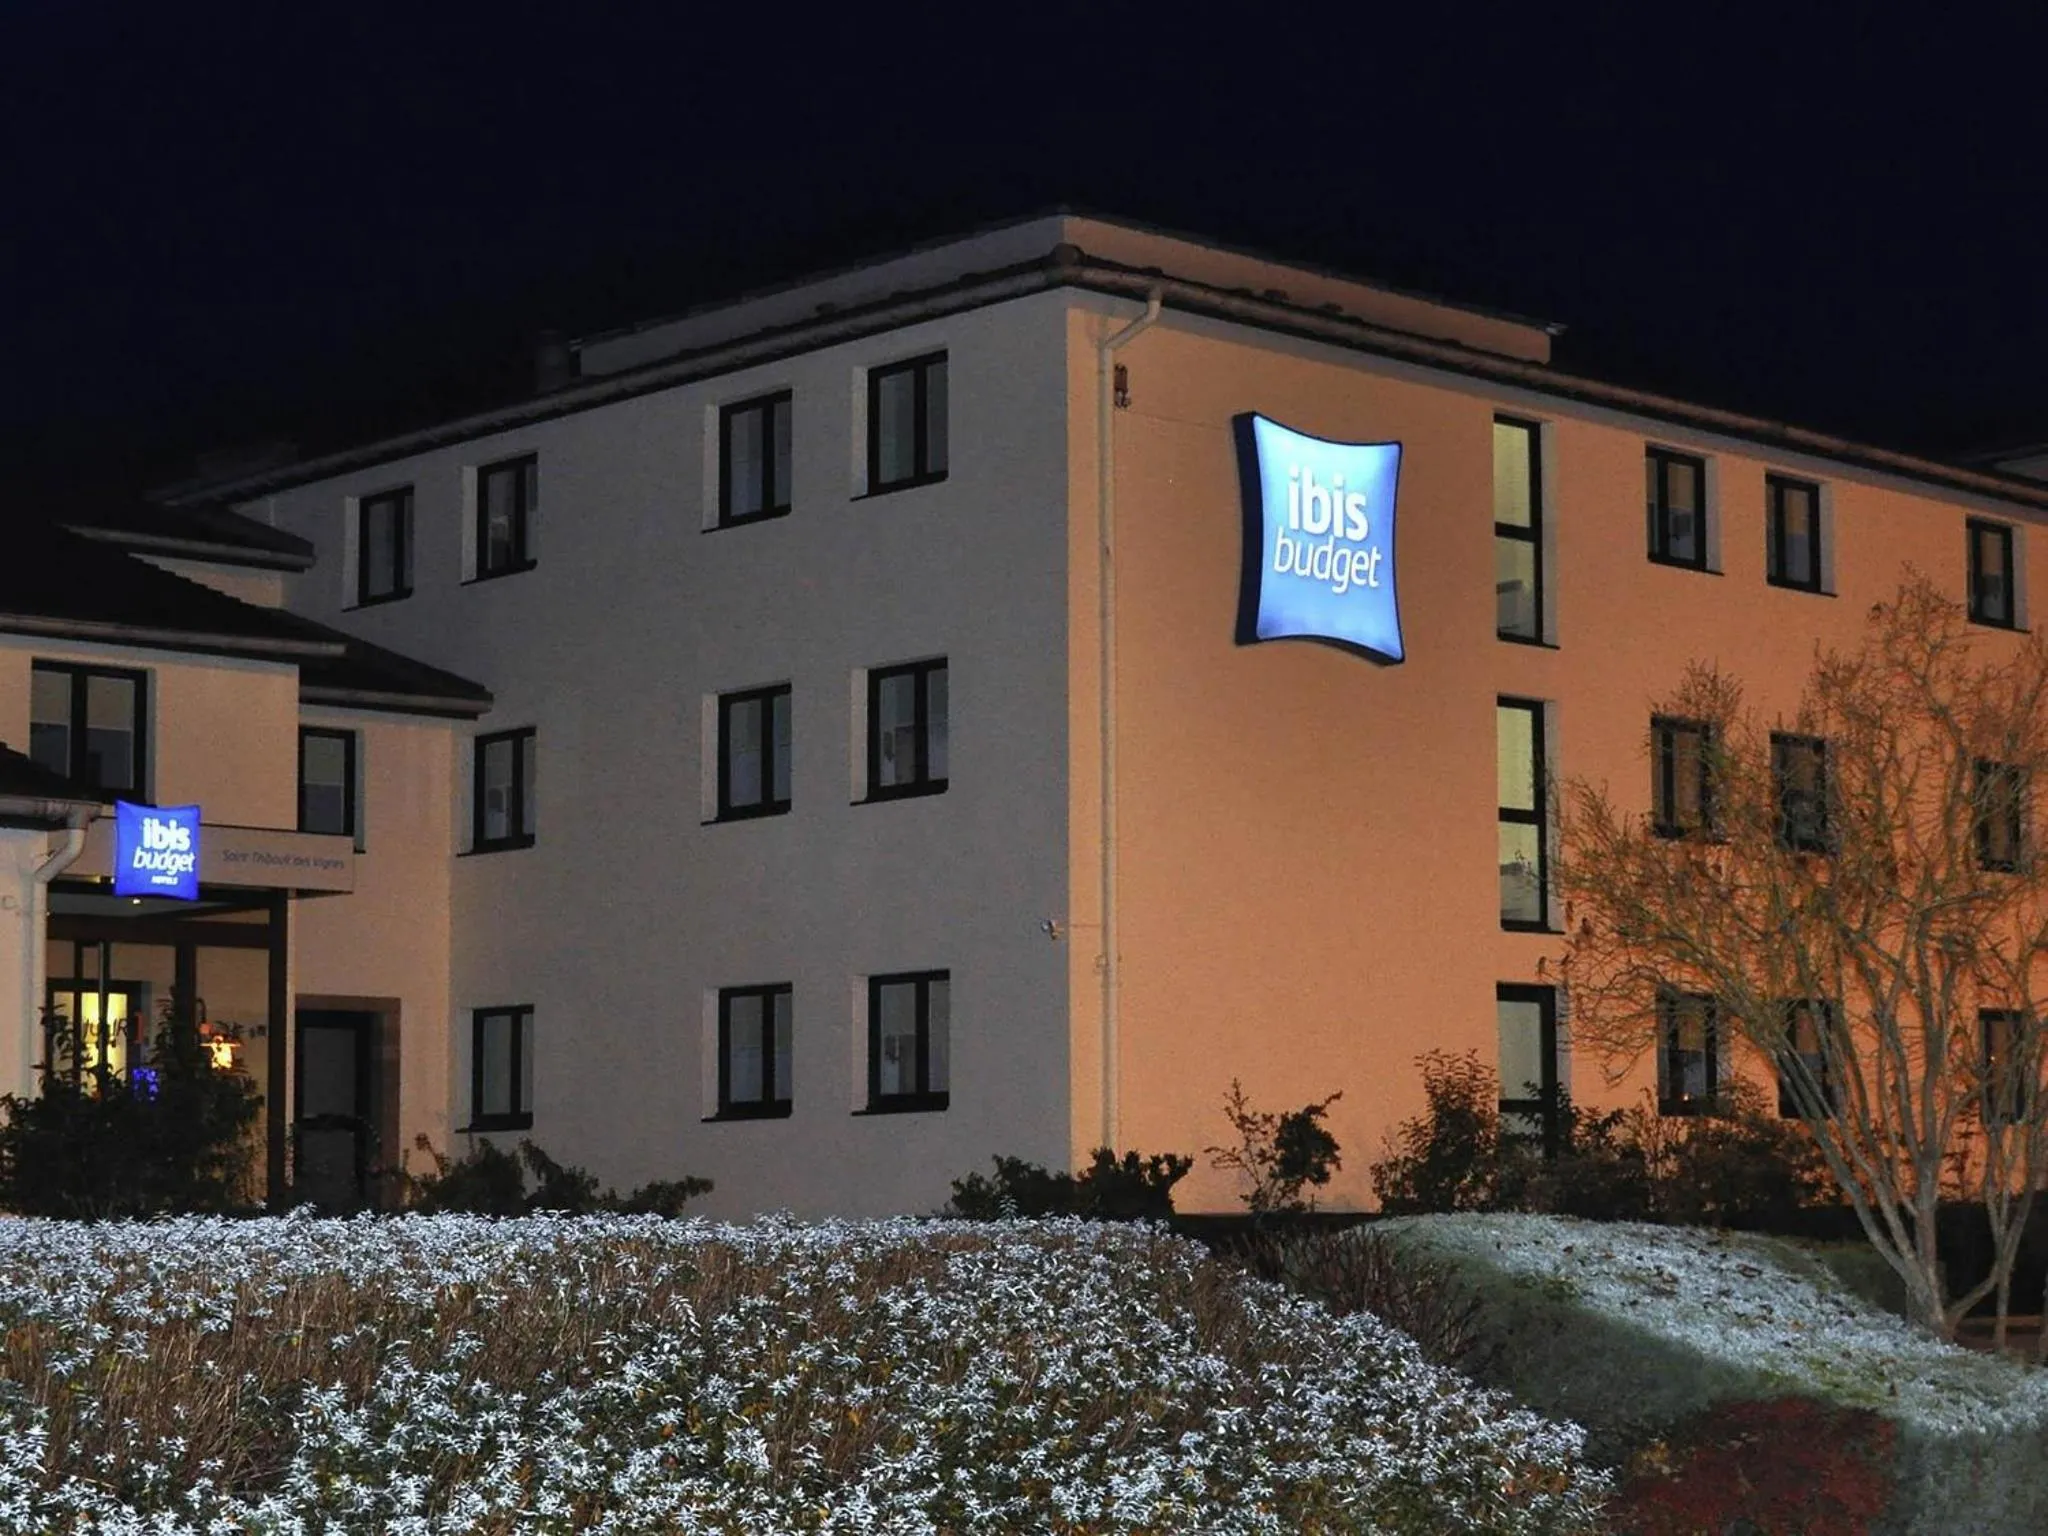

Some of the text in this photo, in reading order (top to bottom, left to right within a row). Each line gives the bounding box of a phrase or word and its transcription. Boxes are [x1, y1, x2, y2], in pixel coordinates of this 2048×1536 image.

[1288, 463, 1369, 542] ibis
[1273, 526, 1382, 594] budget
[143, 817, 191, 851] ibis
[133, 846, 196, 875] budget
